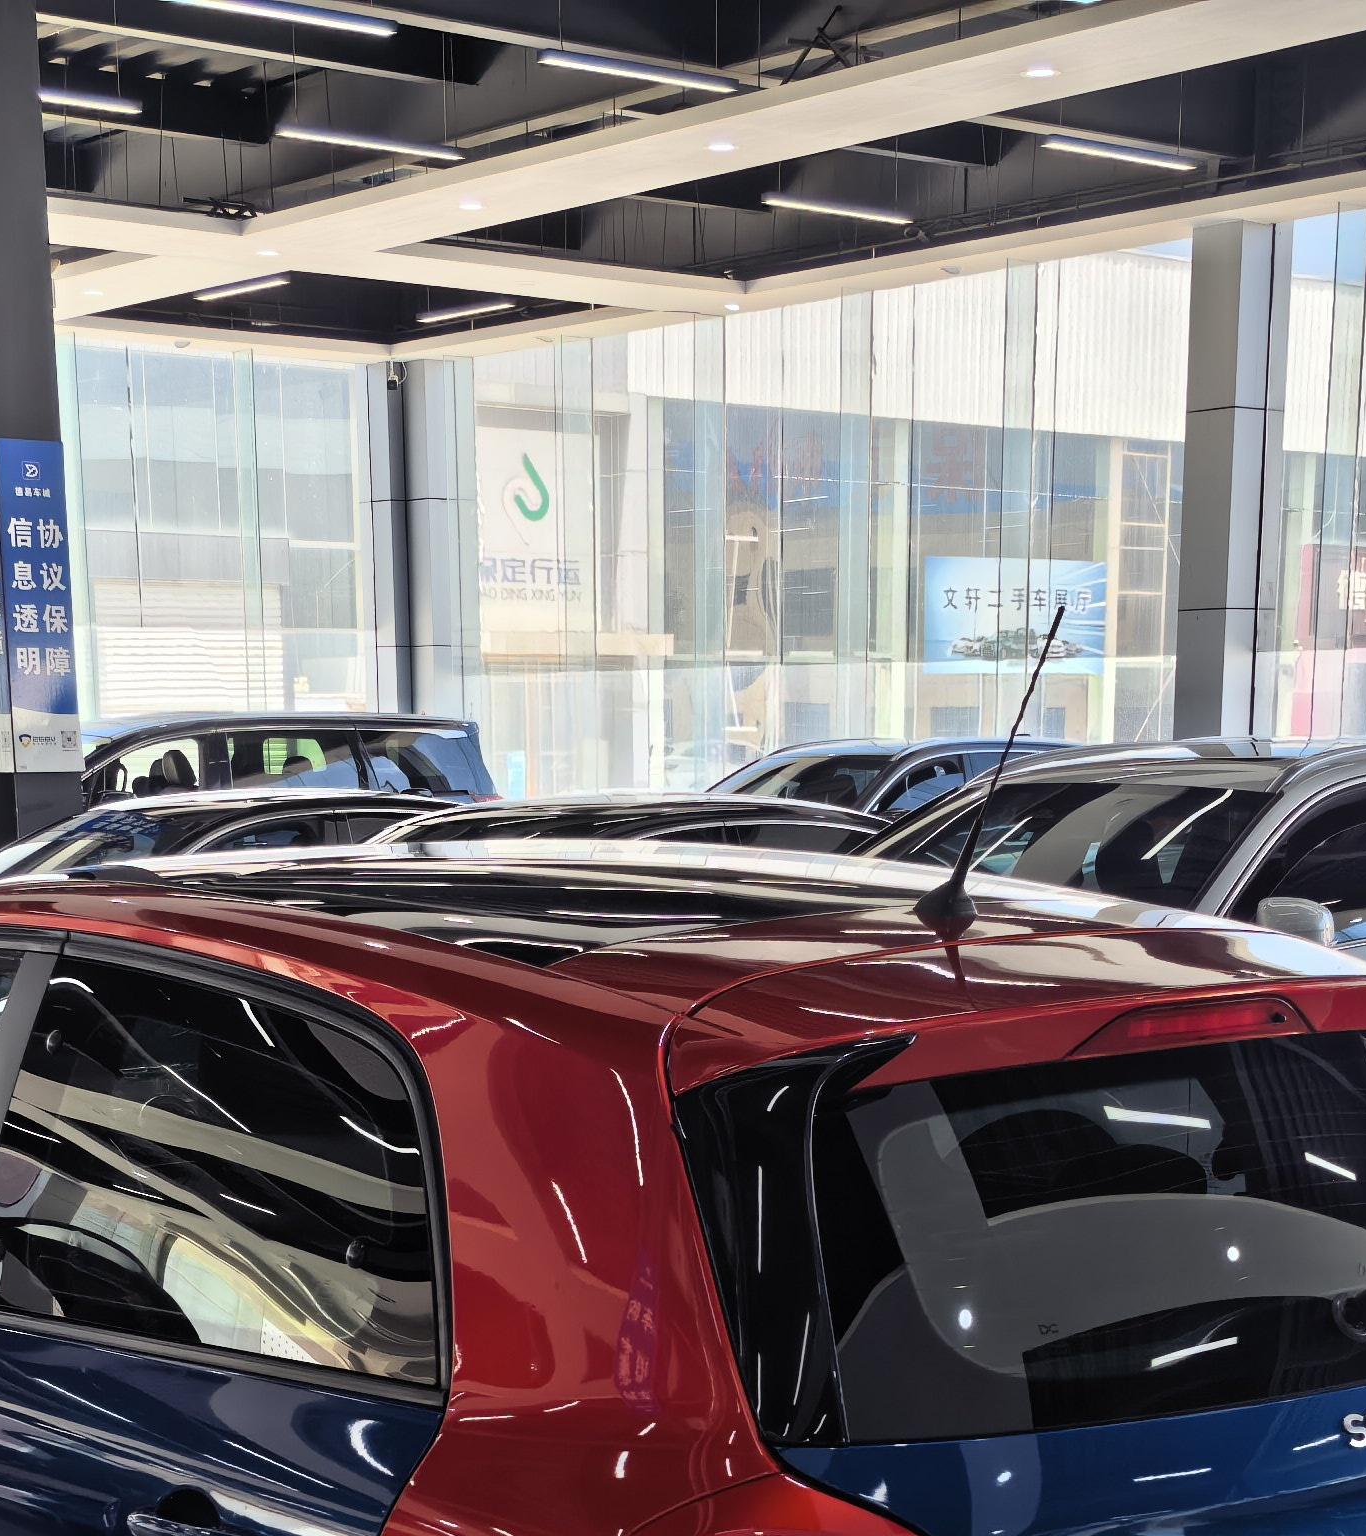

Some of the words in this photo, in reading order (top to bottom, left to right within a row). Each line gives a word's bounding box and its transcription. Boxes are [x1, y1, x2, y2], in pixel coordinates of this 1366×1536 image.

[7, 517, 42, 676] 信息透明
[37, 518, 71, 677] 协议保障
